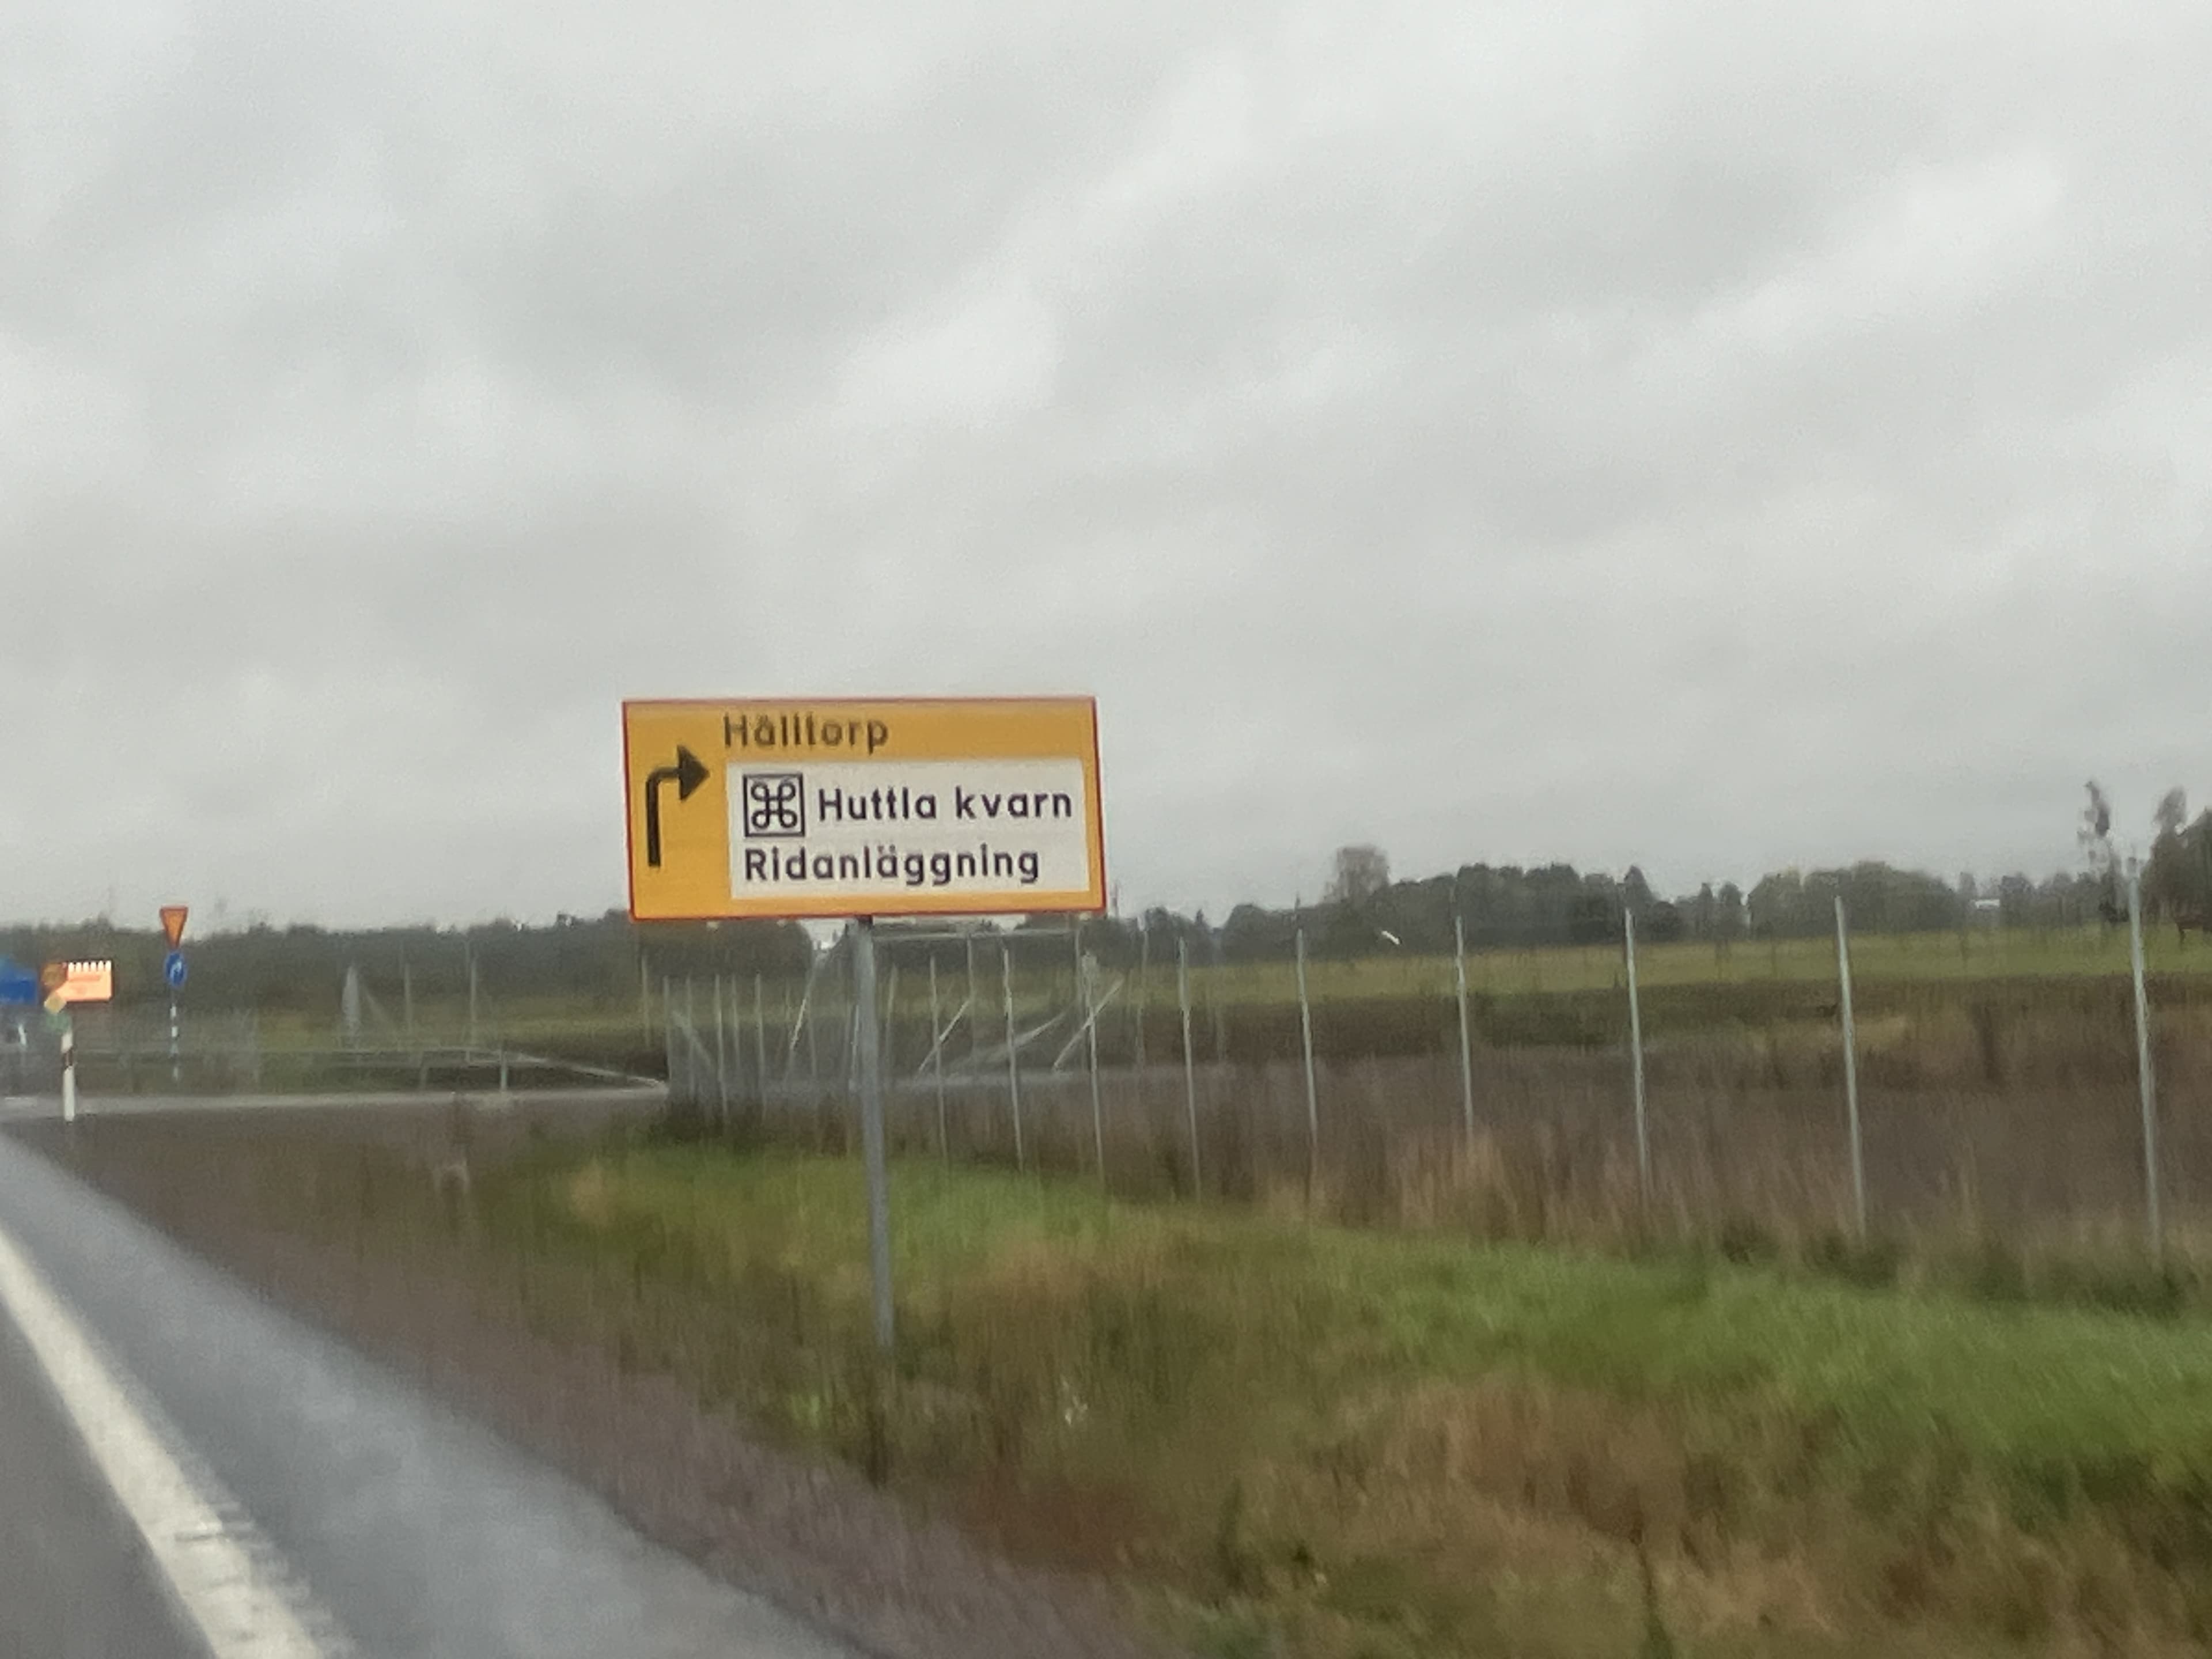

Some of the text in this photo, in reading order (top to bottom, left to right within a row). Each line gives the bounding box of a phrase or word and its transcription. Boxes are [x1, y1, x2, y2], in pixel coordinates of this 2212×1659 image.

[819, 786, 1073, 822] Huttla kvarn
[745, 843, 1039, 886] Ridanläggning
